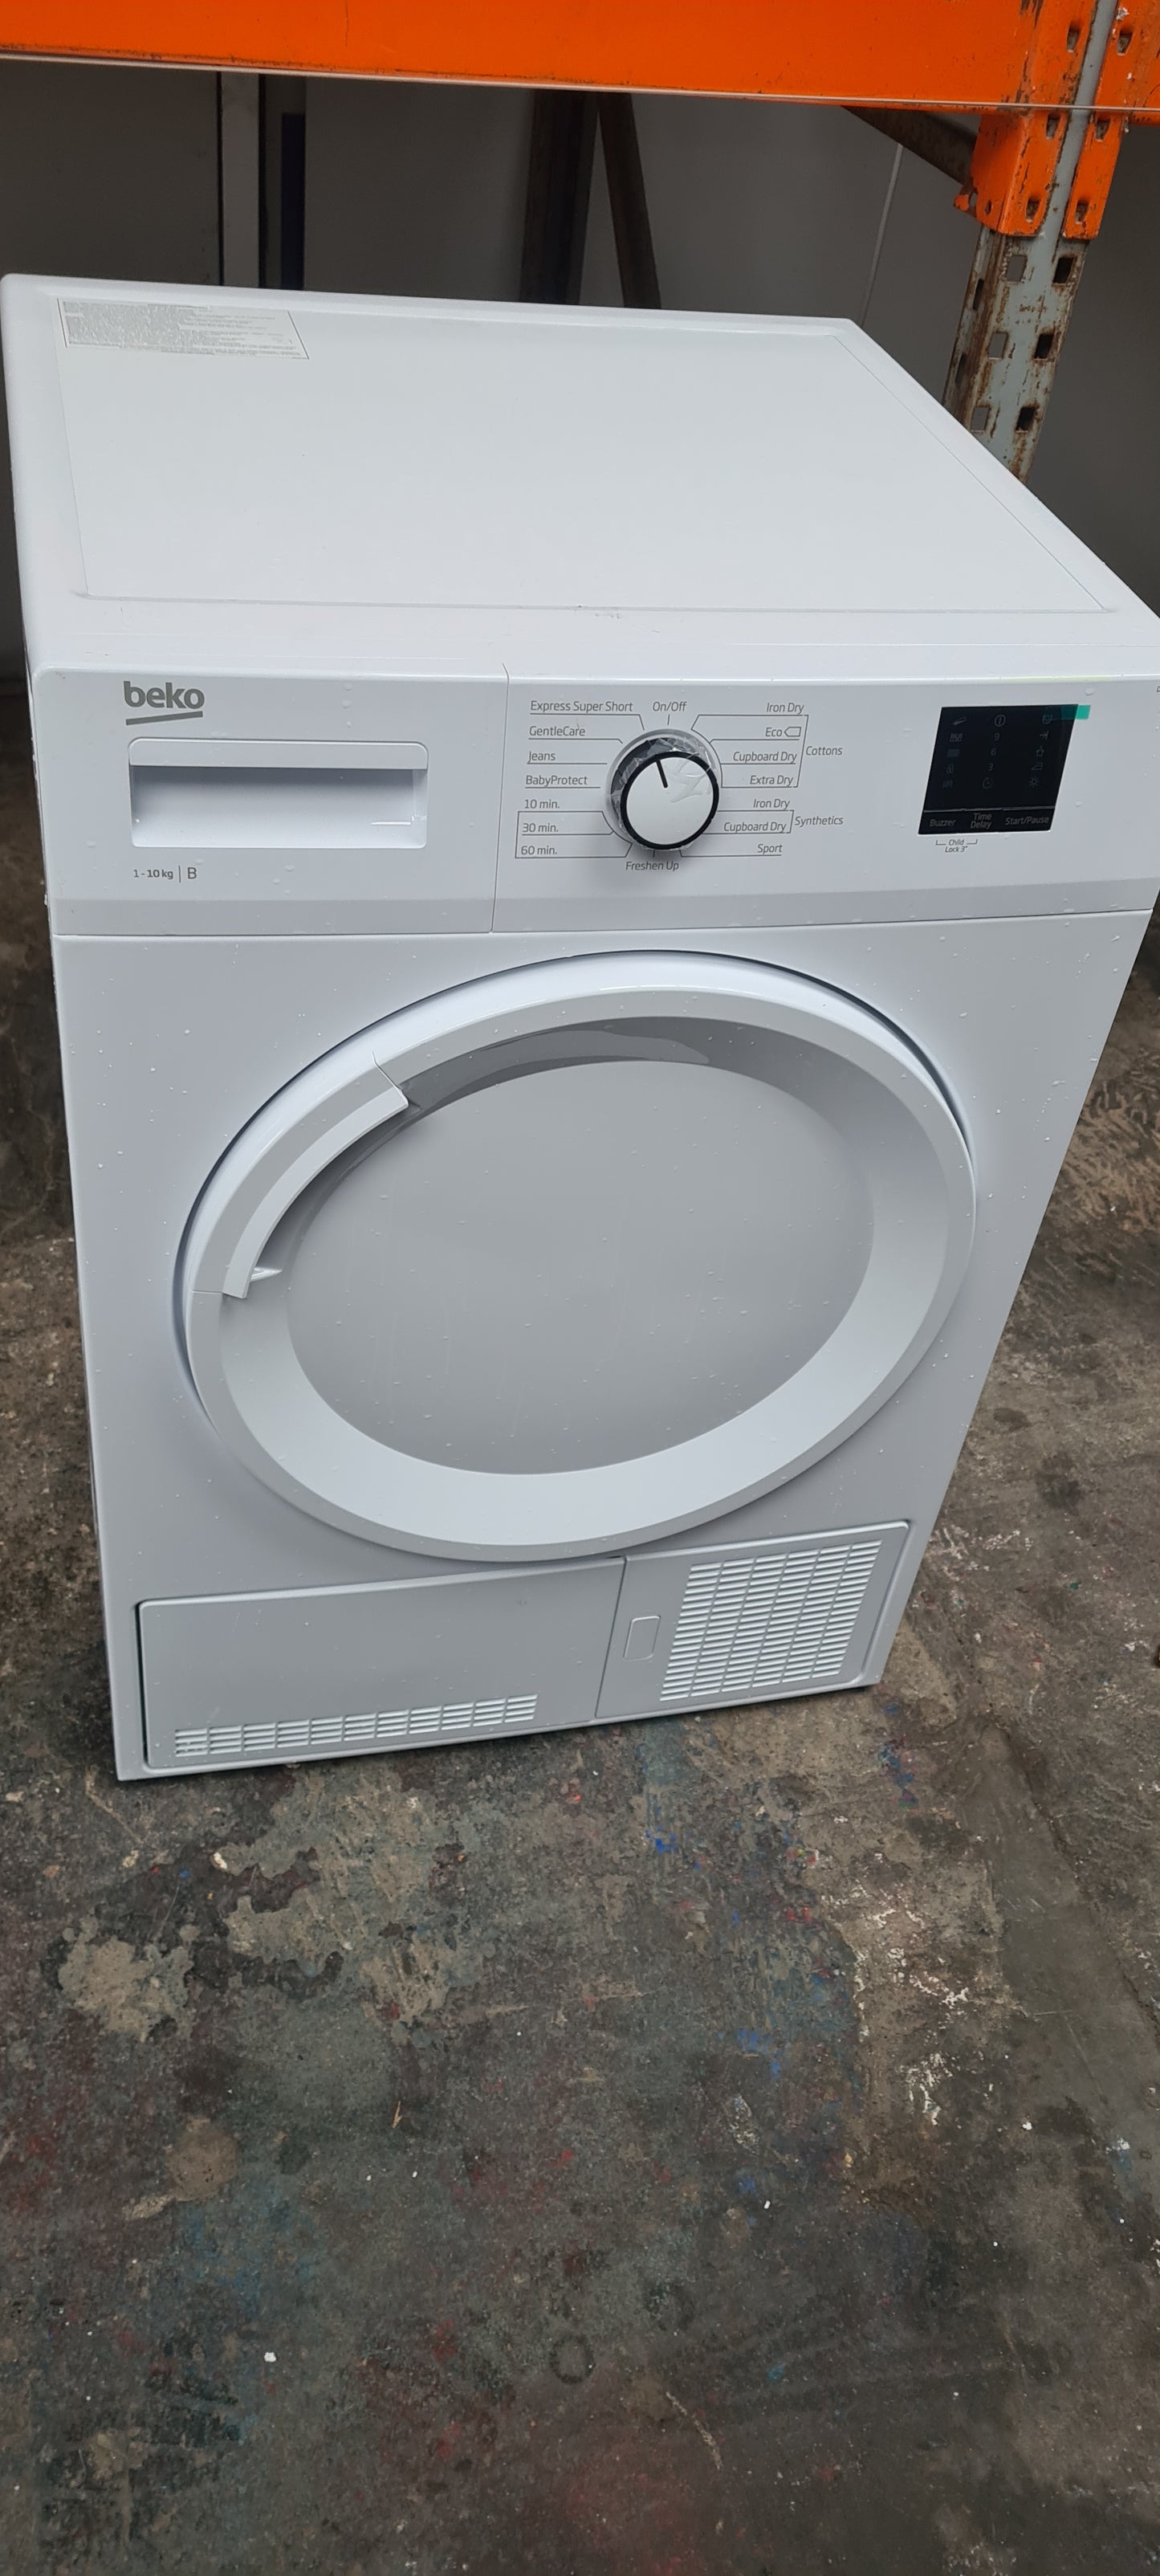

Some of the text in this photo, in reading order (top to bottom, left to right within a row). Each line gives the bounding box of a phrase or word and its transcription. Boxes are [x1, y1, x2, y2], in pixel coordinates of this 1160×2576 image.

[123, 680, 205, 710] beko
[530, 700, 633, 713] Express Super Short
[652, 701, 687, 711] On/Off
[766, 703, 804, 715] Iron Dry
[529, 726, 586, 736] GentleCare
[765, 728, 783, 737] Eco
[805, 746, 843, 756] Cottons
[528, 751, 556, 762] Jeans
[733, 752, 797, 764] Cupboard Dry
[525, 775, 588, 787] BabyProtect
[750, 776, 793, 787] Extra Dry
[524, 799, 560, 809] 10 min.
[753, 799, 790, 809] Iron Dry
[795, 816, 844, 827] Synthetics
[973, 813, 992, 821] Time
[1005, 817, 1049, 825] Start/Pause
[522, 823, 559, 833] 30 min.
[723, 821, 787, 833] Cupboard Dry
[929, 819, 956, 827] Buzzer
[970, 821, 992, 829] Delay
[521, 846, 558, 855] 60 min.
[757, 844, 783, 854] Sport
[625, 861, 679, 871] Freshen Up
[161, 869, 173, 879] kg
[187, 867, 197, 879] B
